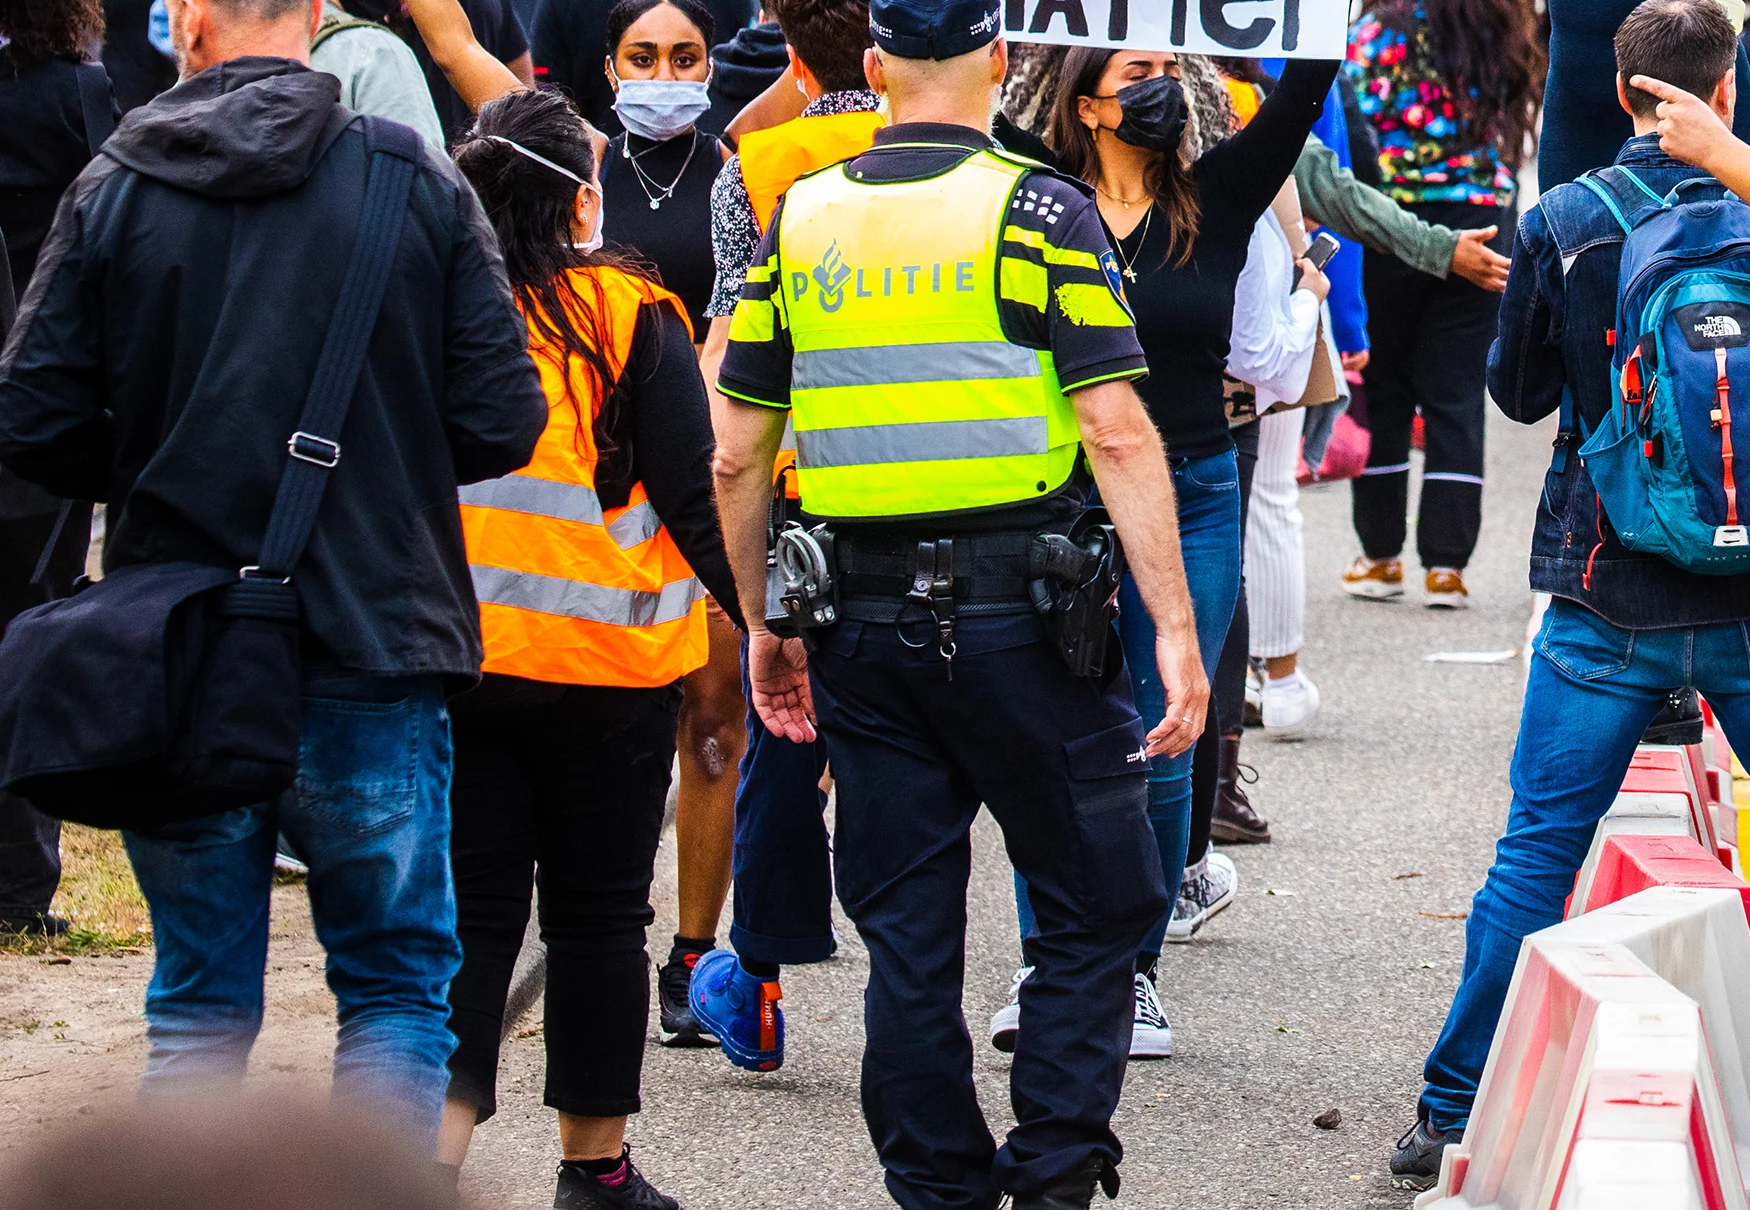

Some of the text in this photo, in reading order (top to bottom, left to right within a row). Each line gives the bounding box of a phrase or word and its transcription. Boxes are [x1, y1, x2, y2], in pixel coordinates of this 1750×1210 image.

[791, 239, 975, 313] POLITIE
[1705, 316, 1724, 324] THE
[1693, 324, 1724, 332] NORTH
[1703, 330, 1726, 338] FACE
